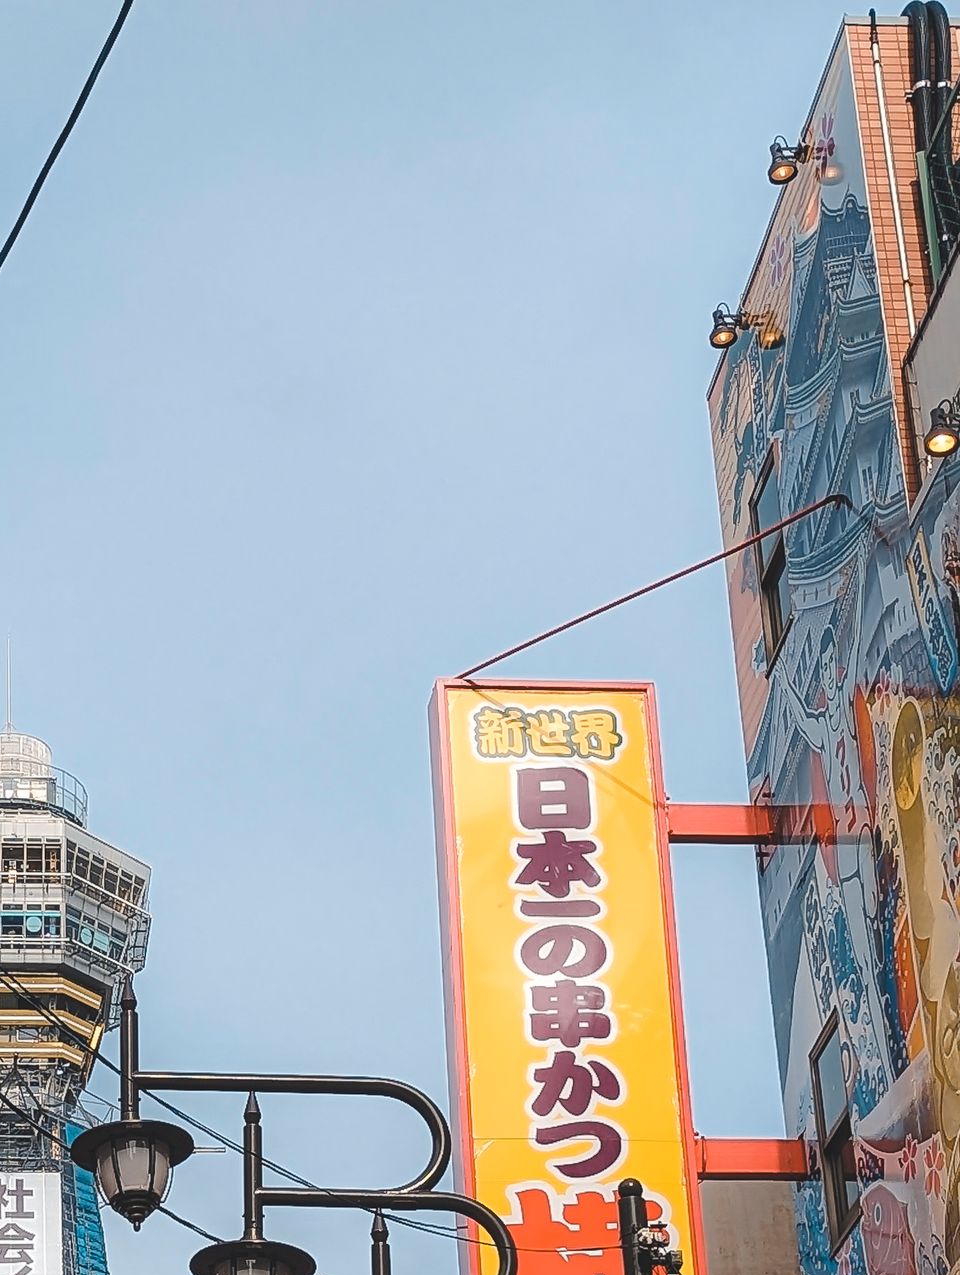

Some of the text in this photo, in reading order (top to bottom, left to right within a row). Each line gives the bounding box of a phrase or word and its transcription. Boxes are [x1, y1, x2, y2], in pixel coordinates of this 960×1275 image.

[475, 709, 621, 758] 新世界
[514, 766, 622, 1178] 日本一の串かつ
